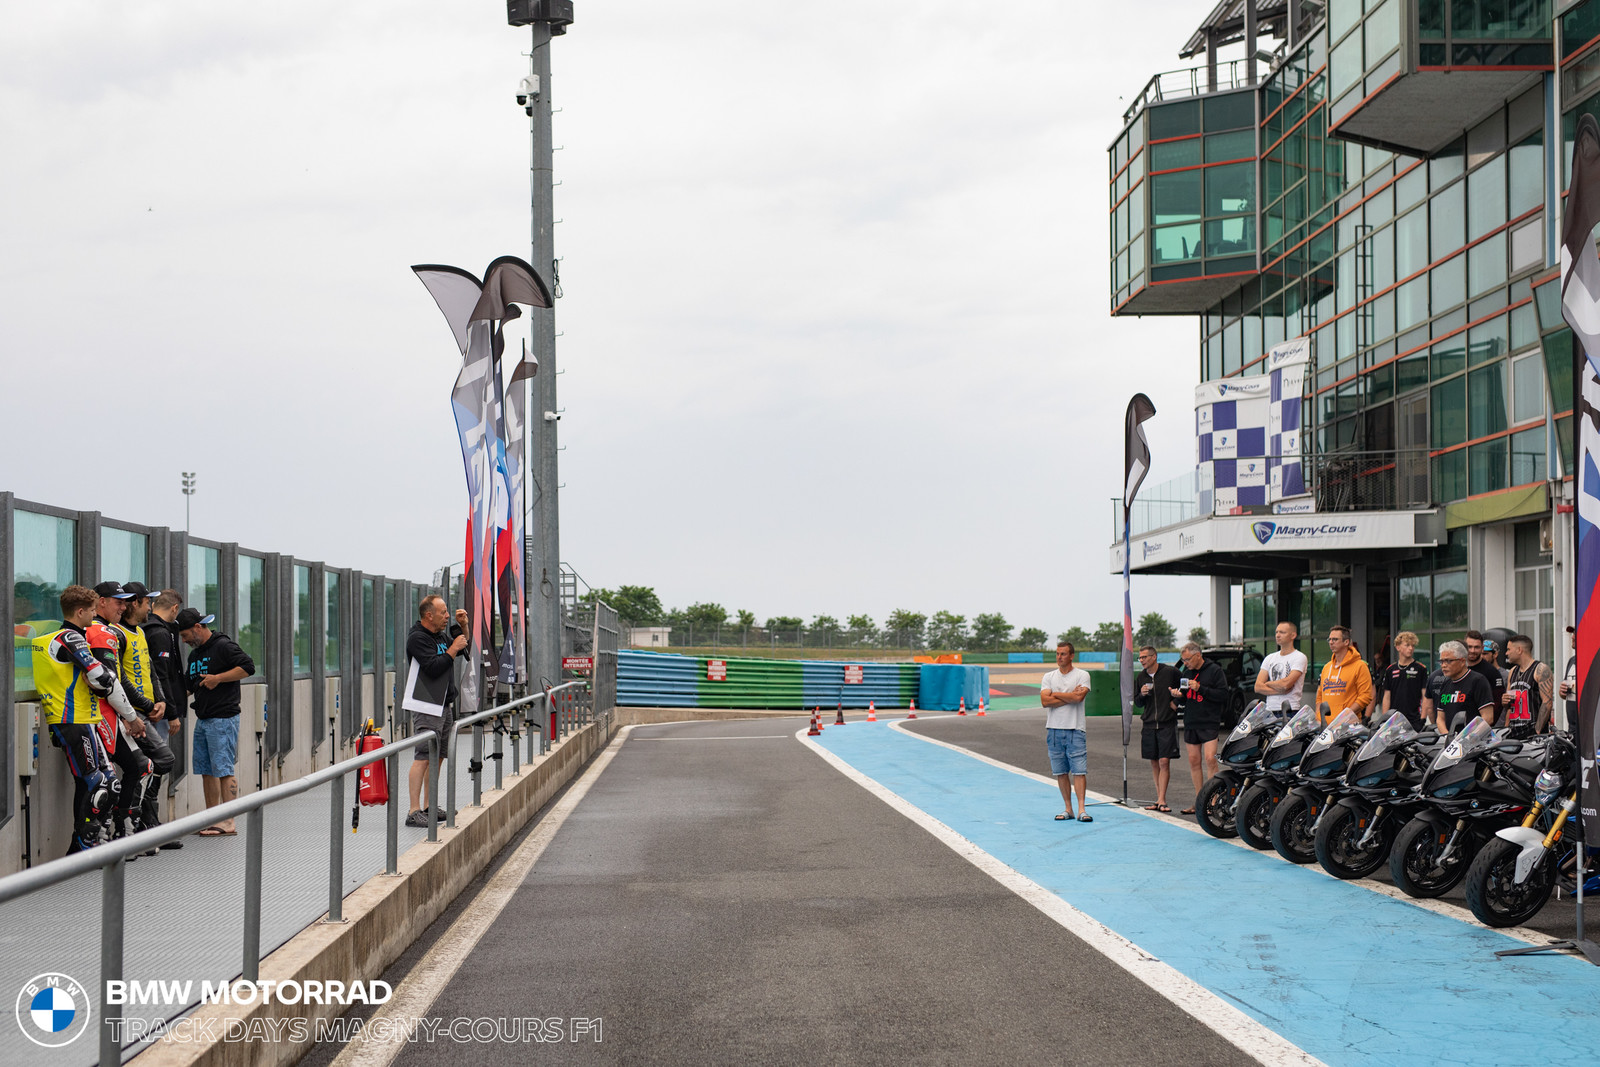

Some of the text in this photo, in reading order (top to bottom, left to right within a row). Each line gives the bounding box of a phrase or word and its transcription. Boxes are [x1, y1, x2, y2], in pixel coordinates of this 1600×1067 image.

[1276, 524, 1357, 537] Magny-Cours
[131, 640, 144, 696] ACKDAYS
[1446, 743, 1459, 756] 81
